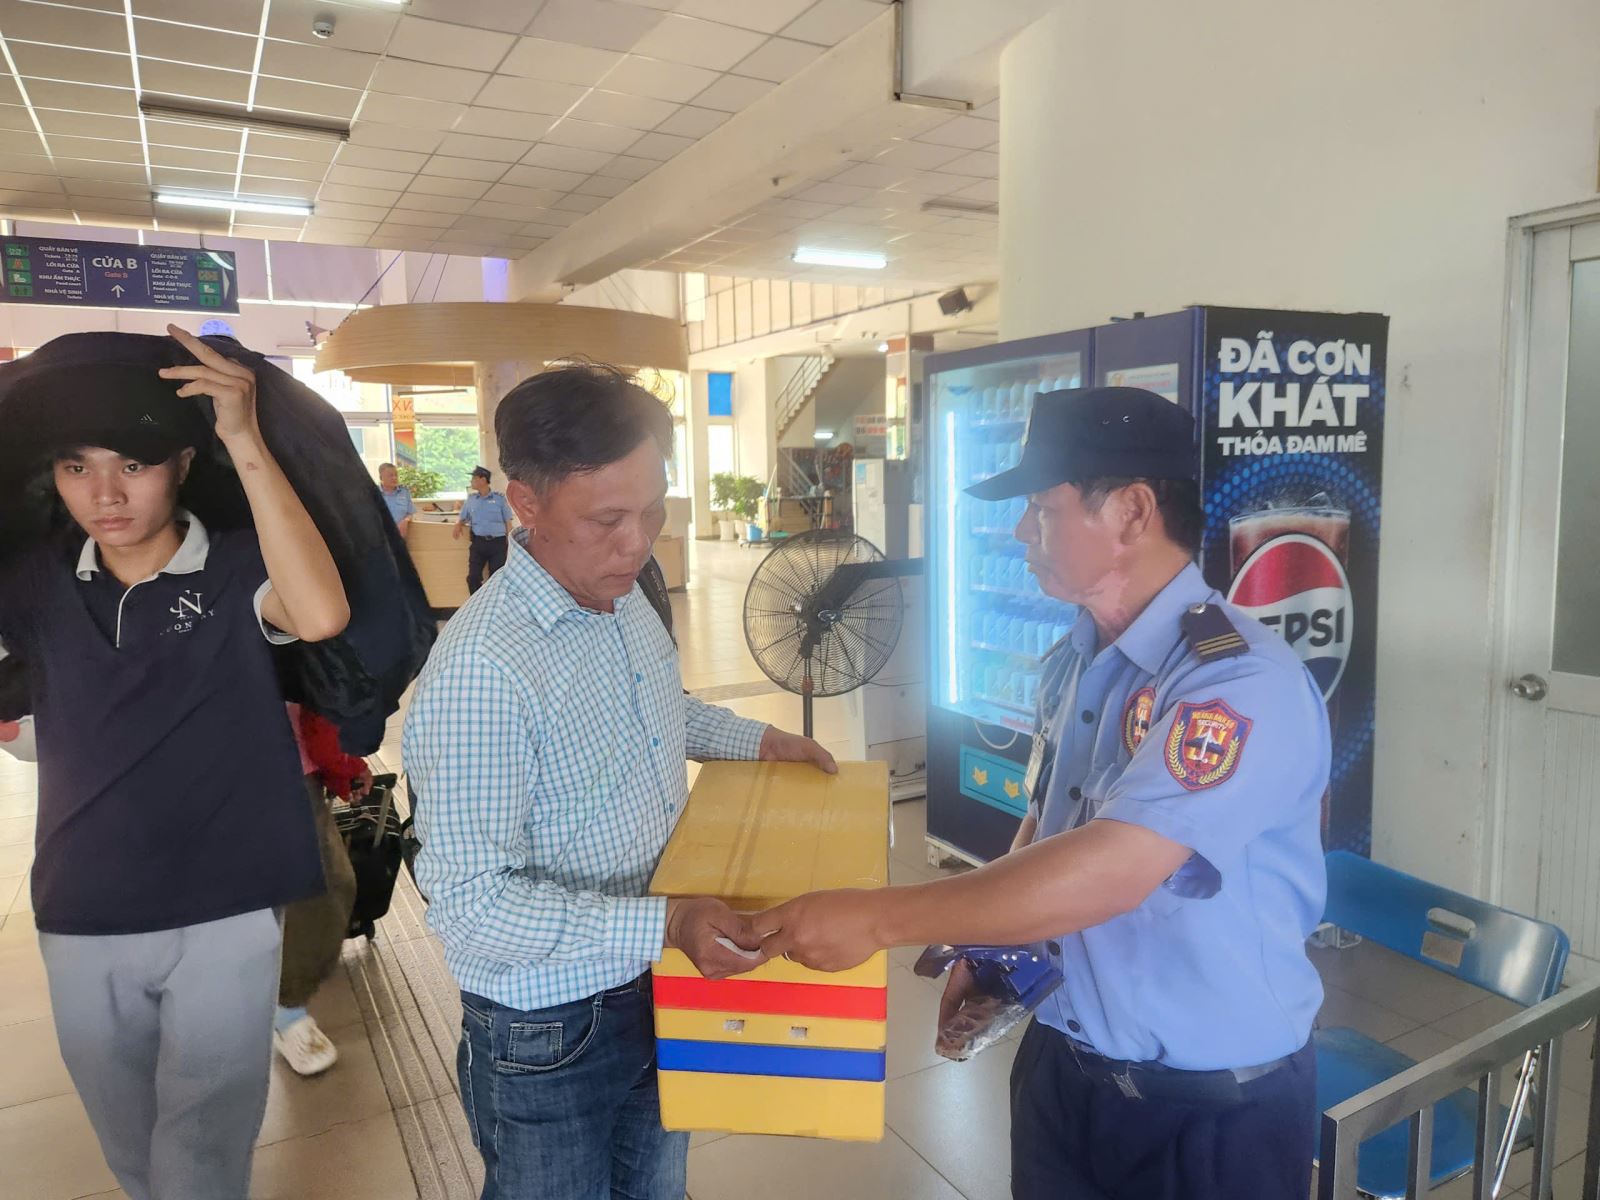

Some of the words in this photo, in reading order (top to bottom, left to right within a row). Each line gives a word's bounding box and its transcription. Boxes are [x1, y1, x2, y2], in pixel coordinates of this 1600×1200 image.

[92, 256, 124, 269] CỬA
[126, 258, 138, 269] B
[1217, 330, 1281, 374] ĐÃ
[1287, 338, 1371, 376] CƠN
[1218, 376, 1370, 428] KHÁT
[1217, 430, 1284, 456] THỎA
[1286, 435, 1334, 454] ĐAM
[1337, 431, 1367, 453] MÊ
